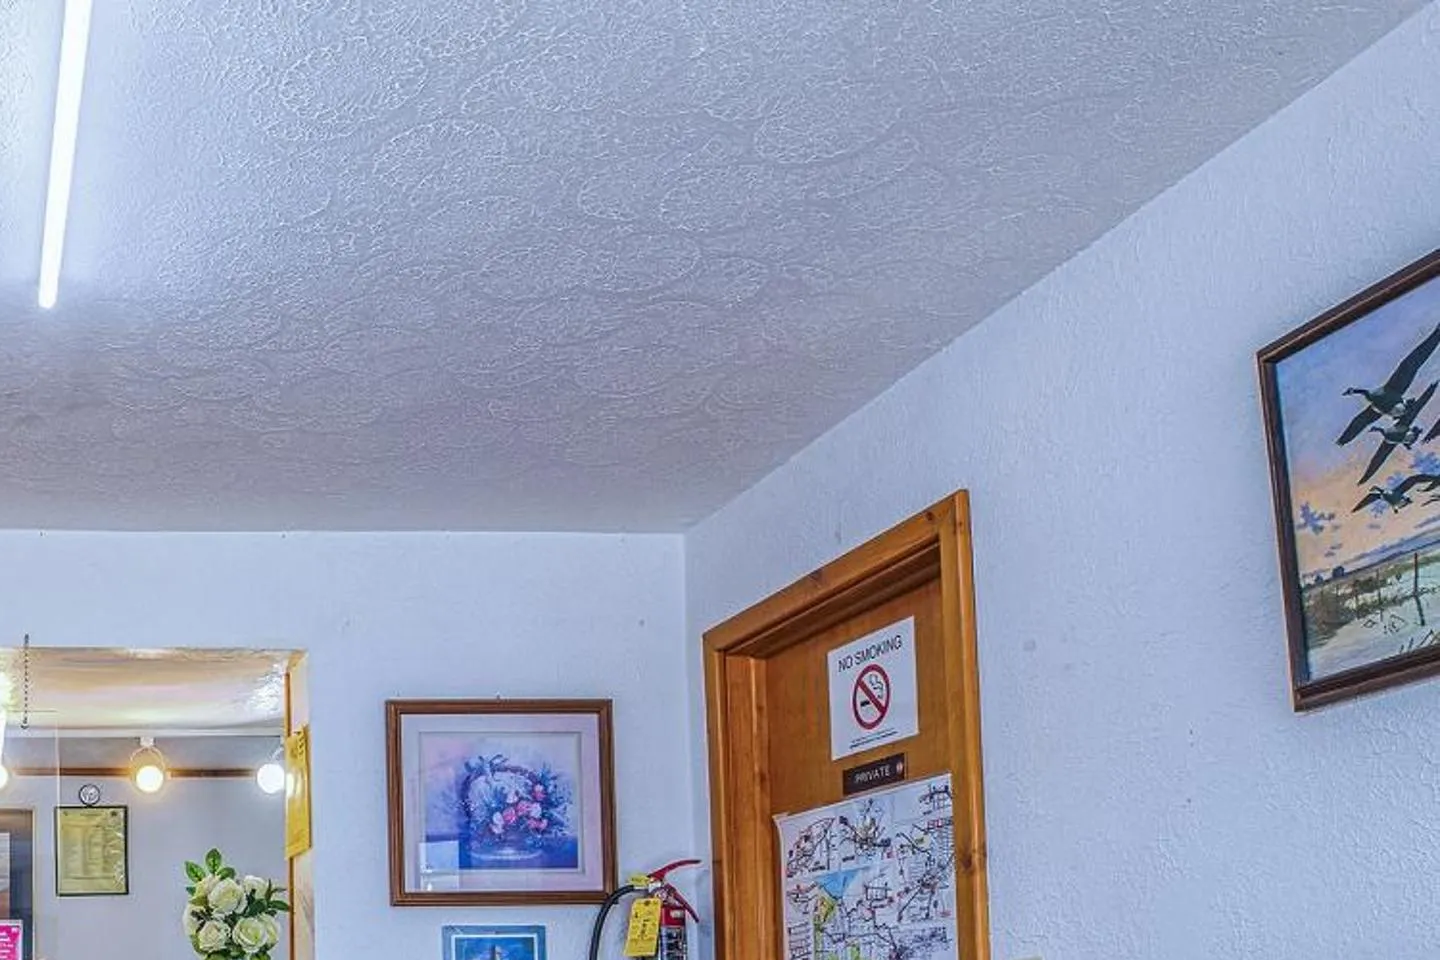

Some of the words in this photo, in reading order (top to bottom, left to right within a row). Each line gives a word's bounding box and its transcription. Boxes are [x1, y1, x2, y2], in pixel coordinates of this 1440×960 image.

[838, 655, 853, 672] NO
[855, 635, 902, 665] SMOKING
[854, 764, 891, 783] PRIVATE
